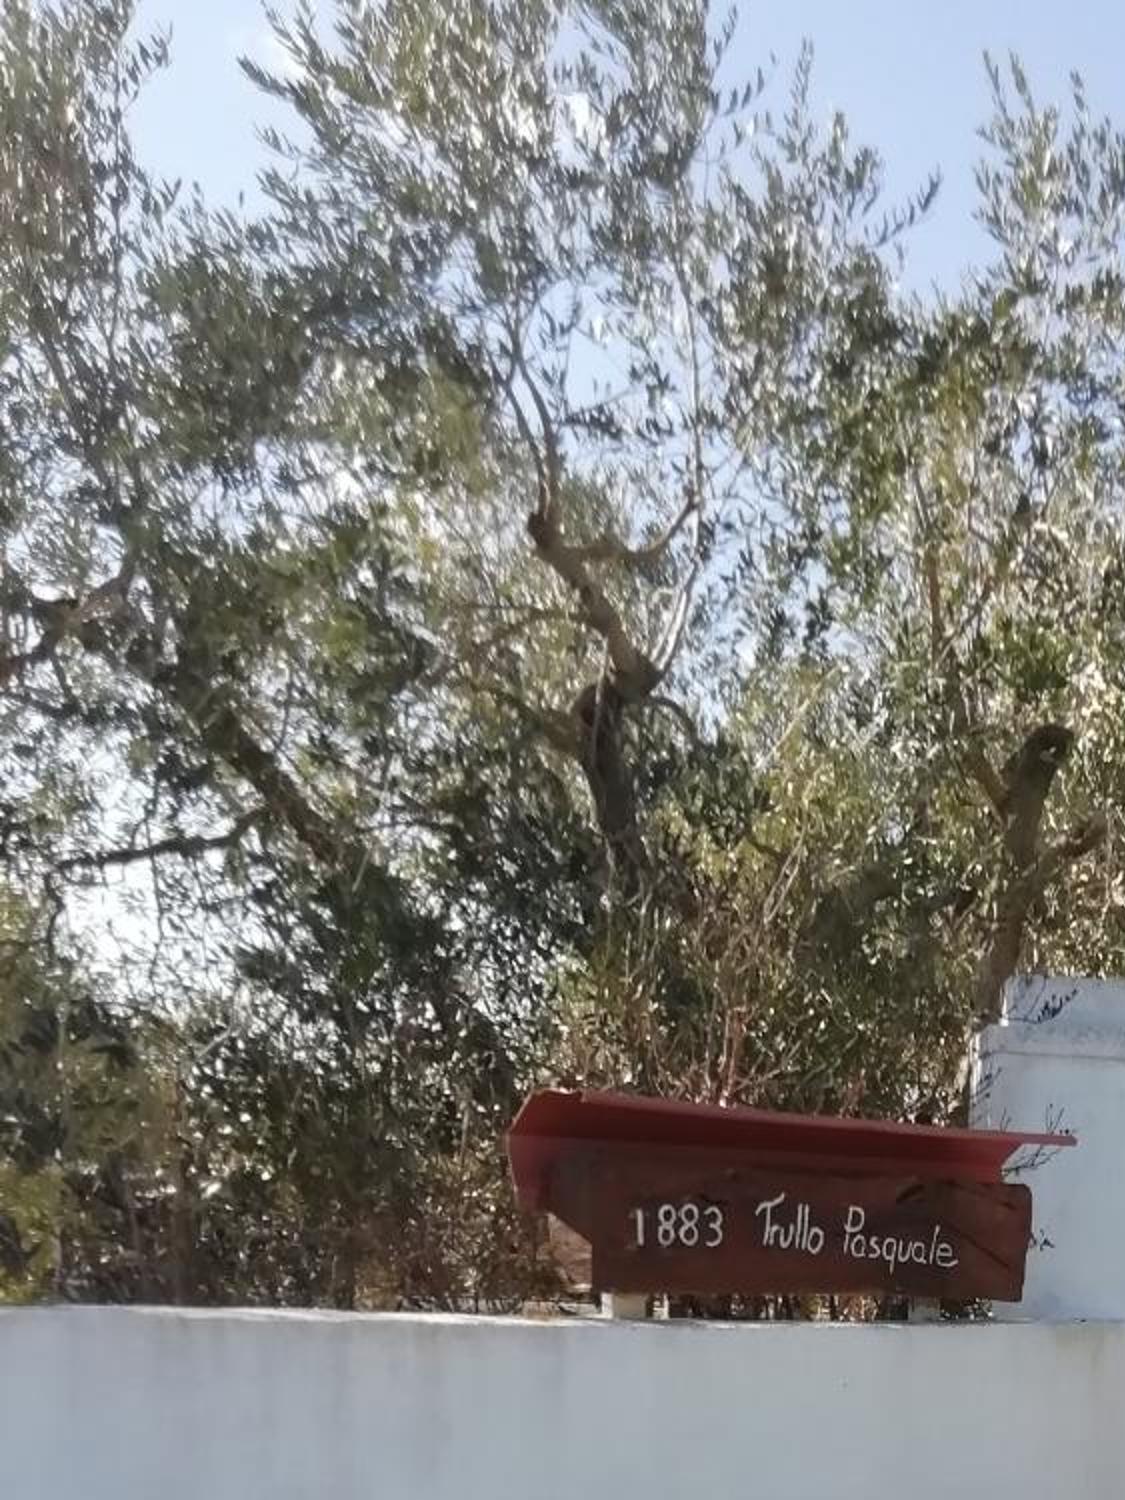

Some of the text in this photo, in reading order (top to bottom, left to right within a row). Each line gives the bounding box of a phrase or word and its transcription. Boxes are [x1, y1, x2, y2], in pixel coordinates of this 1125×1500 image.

[633, 1192, 958, 1275] 1883 Trullo Pasquale
